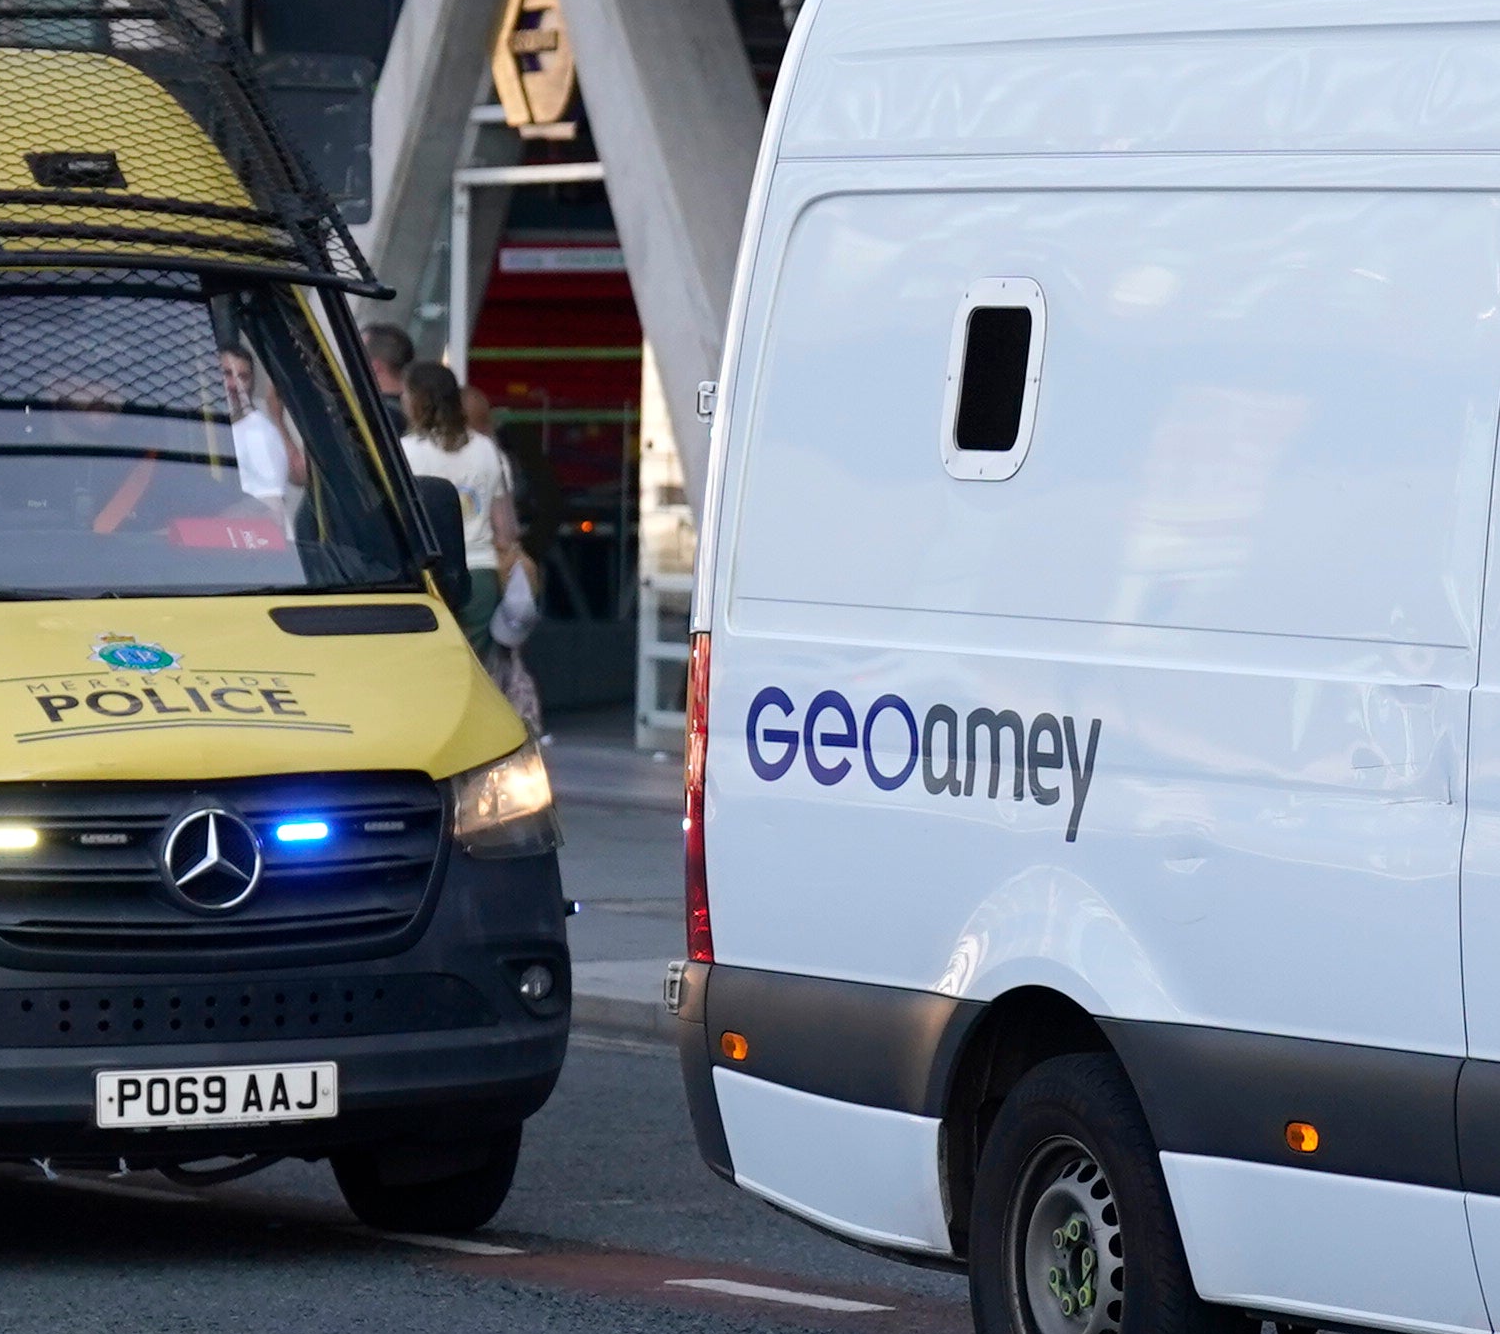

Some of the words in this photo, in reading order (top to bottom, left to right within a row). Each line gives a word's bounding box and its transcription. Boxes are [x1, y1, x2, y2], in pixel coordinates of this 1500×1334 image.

[26, 672, 289, 694] MERSEYSIDE
[35, 686, 308, 723] POLICE
[117, 1075, 226, 1117] PO69
[241, 1070, 318, 1113] AAJ
